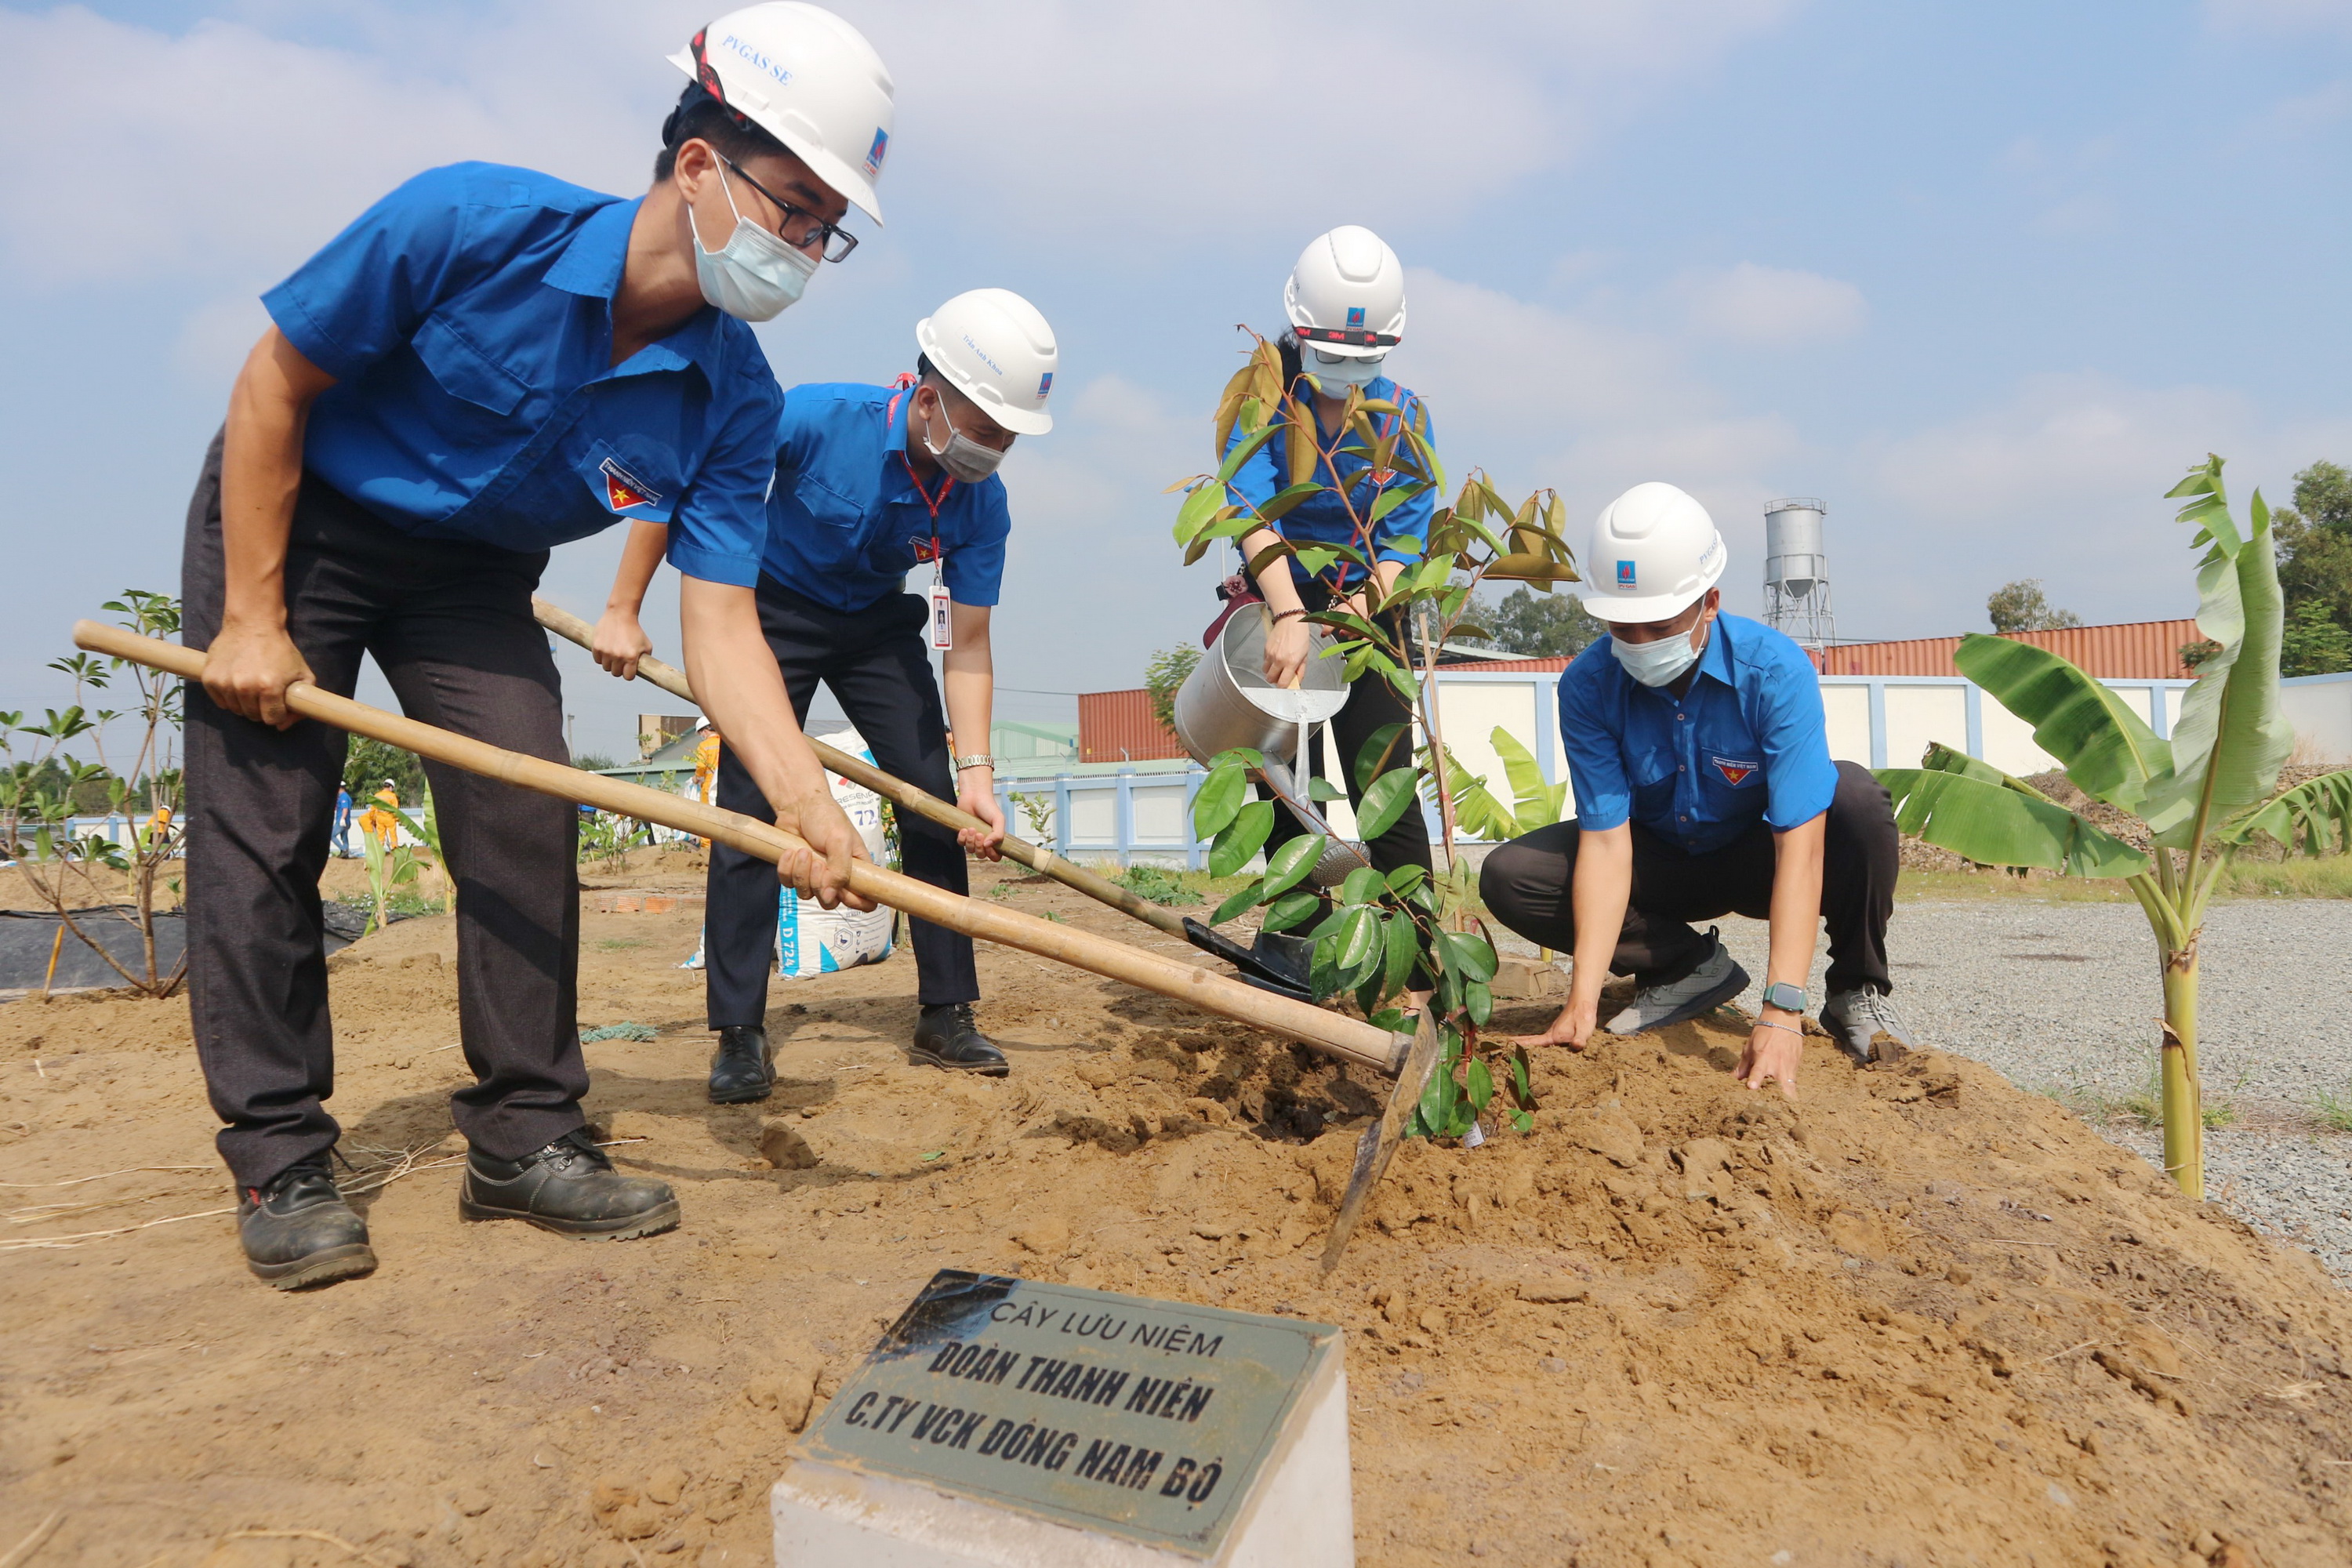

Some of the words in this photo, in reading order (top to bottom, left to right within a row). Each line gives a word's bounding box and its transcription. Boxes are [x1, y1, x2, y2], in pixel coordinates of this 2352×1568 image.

[722, 34, 771, 70] PVGAS
[769, 64, 793, 86] SE
[1327, 331, 1345, 340] 3M
[974, 348, 987, 361] Anh
[986, 358, 1004, 376] Khoa
[782, 927, 793, 938] D
[784, 942, 795, 967] 724
[989, 1301, 1058, 1329] CÂY
[1061, 1312, 1127, 1341] LƯU
[1129, 1323, 1224, 1358] NIỆM
[1016, 1356, 1130, 1406] THANH
[1124, 1377, 1214, 1423] NIÊN
[845, 1391, 921, 1434] C.TY
[910, 1403, 988, 1450] VCK
[1073, 1438, 1165, 1491] NAM
[1159, 1457, 1223, 1512] BỘ
